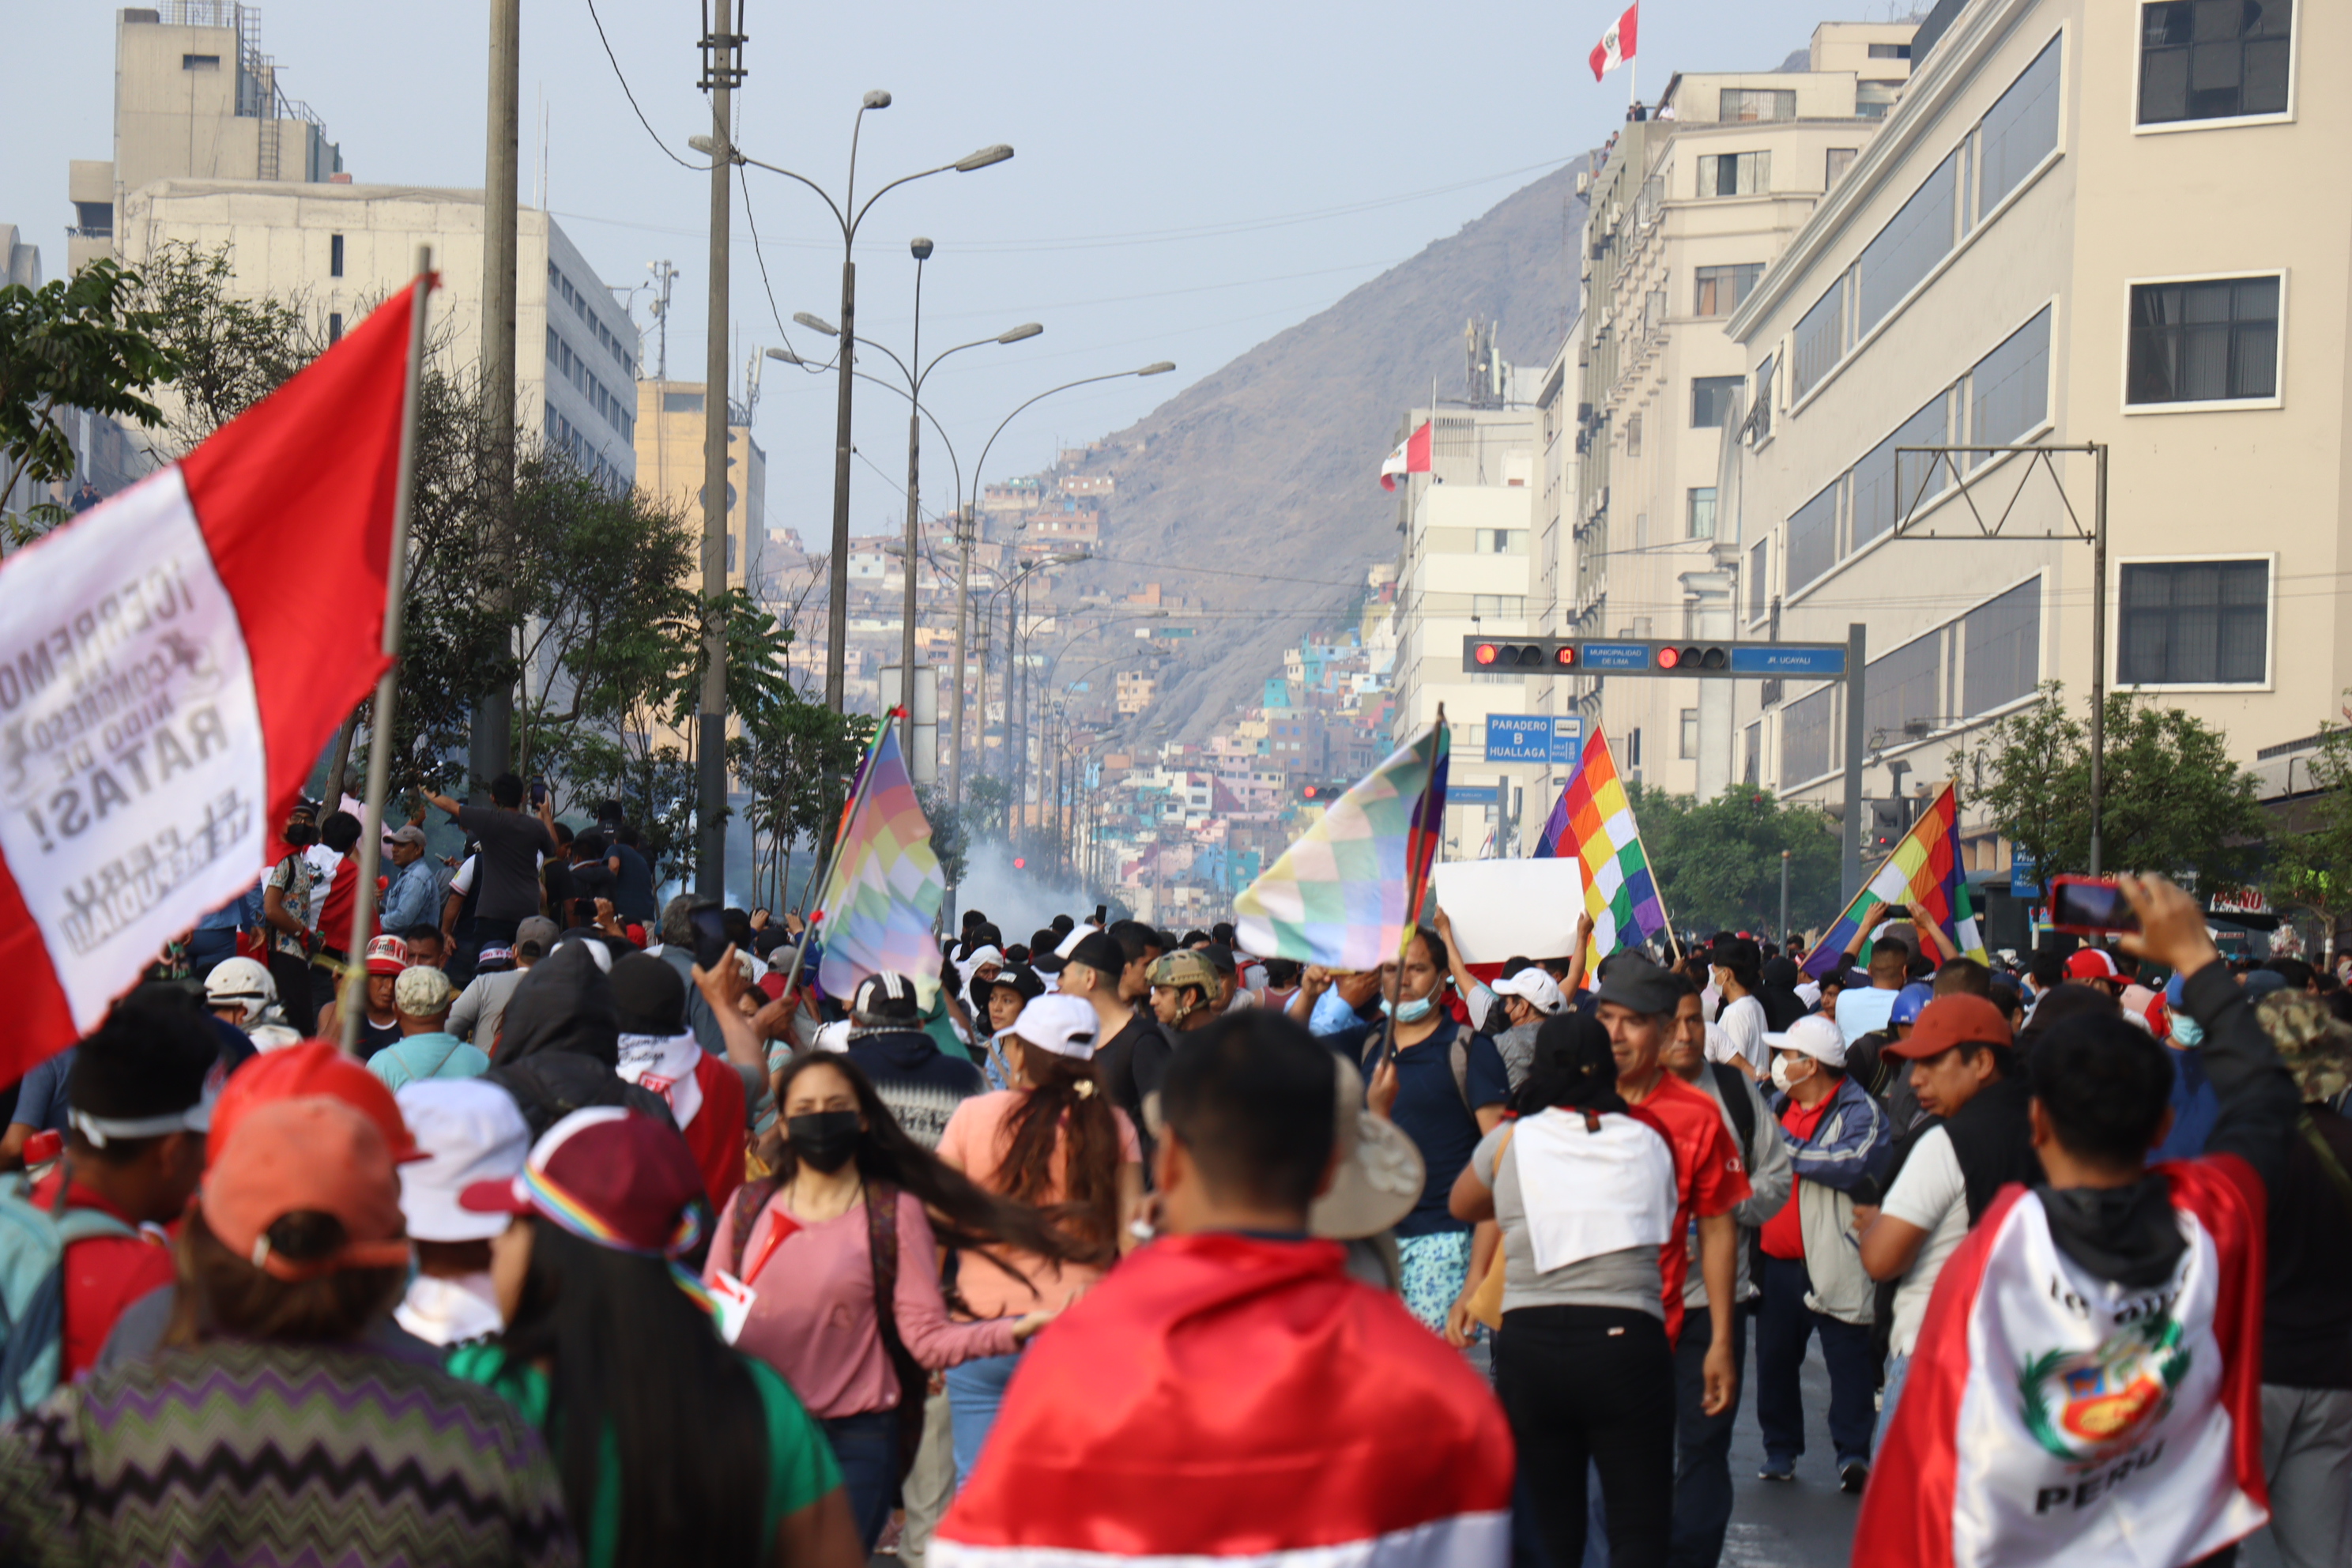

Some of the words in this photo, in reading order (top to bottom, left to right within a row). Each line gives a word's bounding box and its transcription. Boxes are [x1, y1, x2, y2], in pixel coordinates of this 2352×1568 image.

[1560, 649, 1571, 663] 10
[1589, 648, 1642, 658] MUNICIPALIDAD
[1780, 656, 1811, 665] UCAYALI
[1492, 719, 1547, 731] PARADERO
[1513, 733, 1523, 744] B
[1490, 747, 1546, 758] HUALLAGA
[2036, 1438, 2165, 1515] PERU
